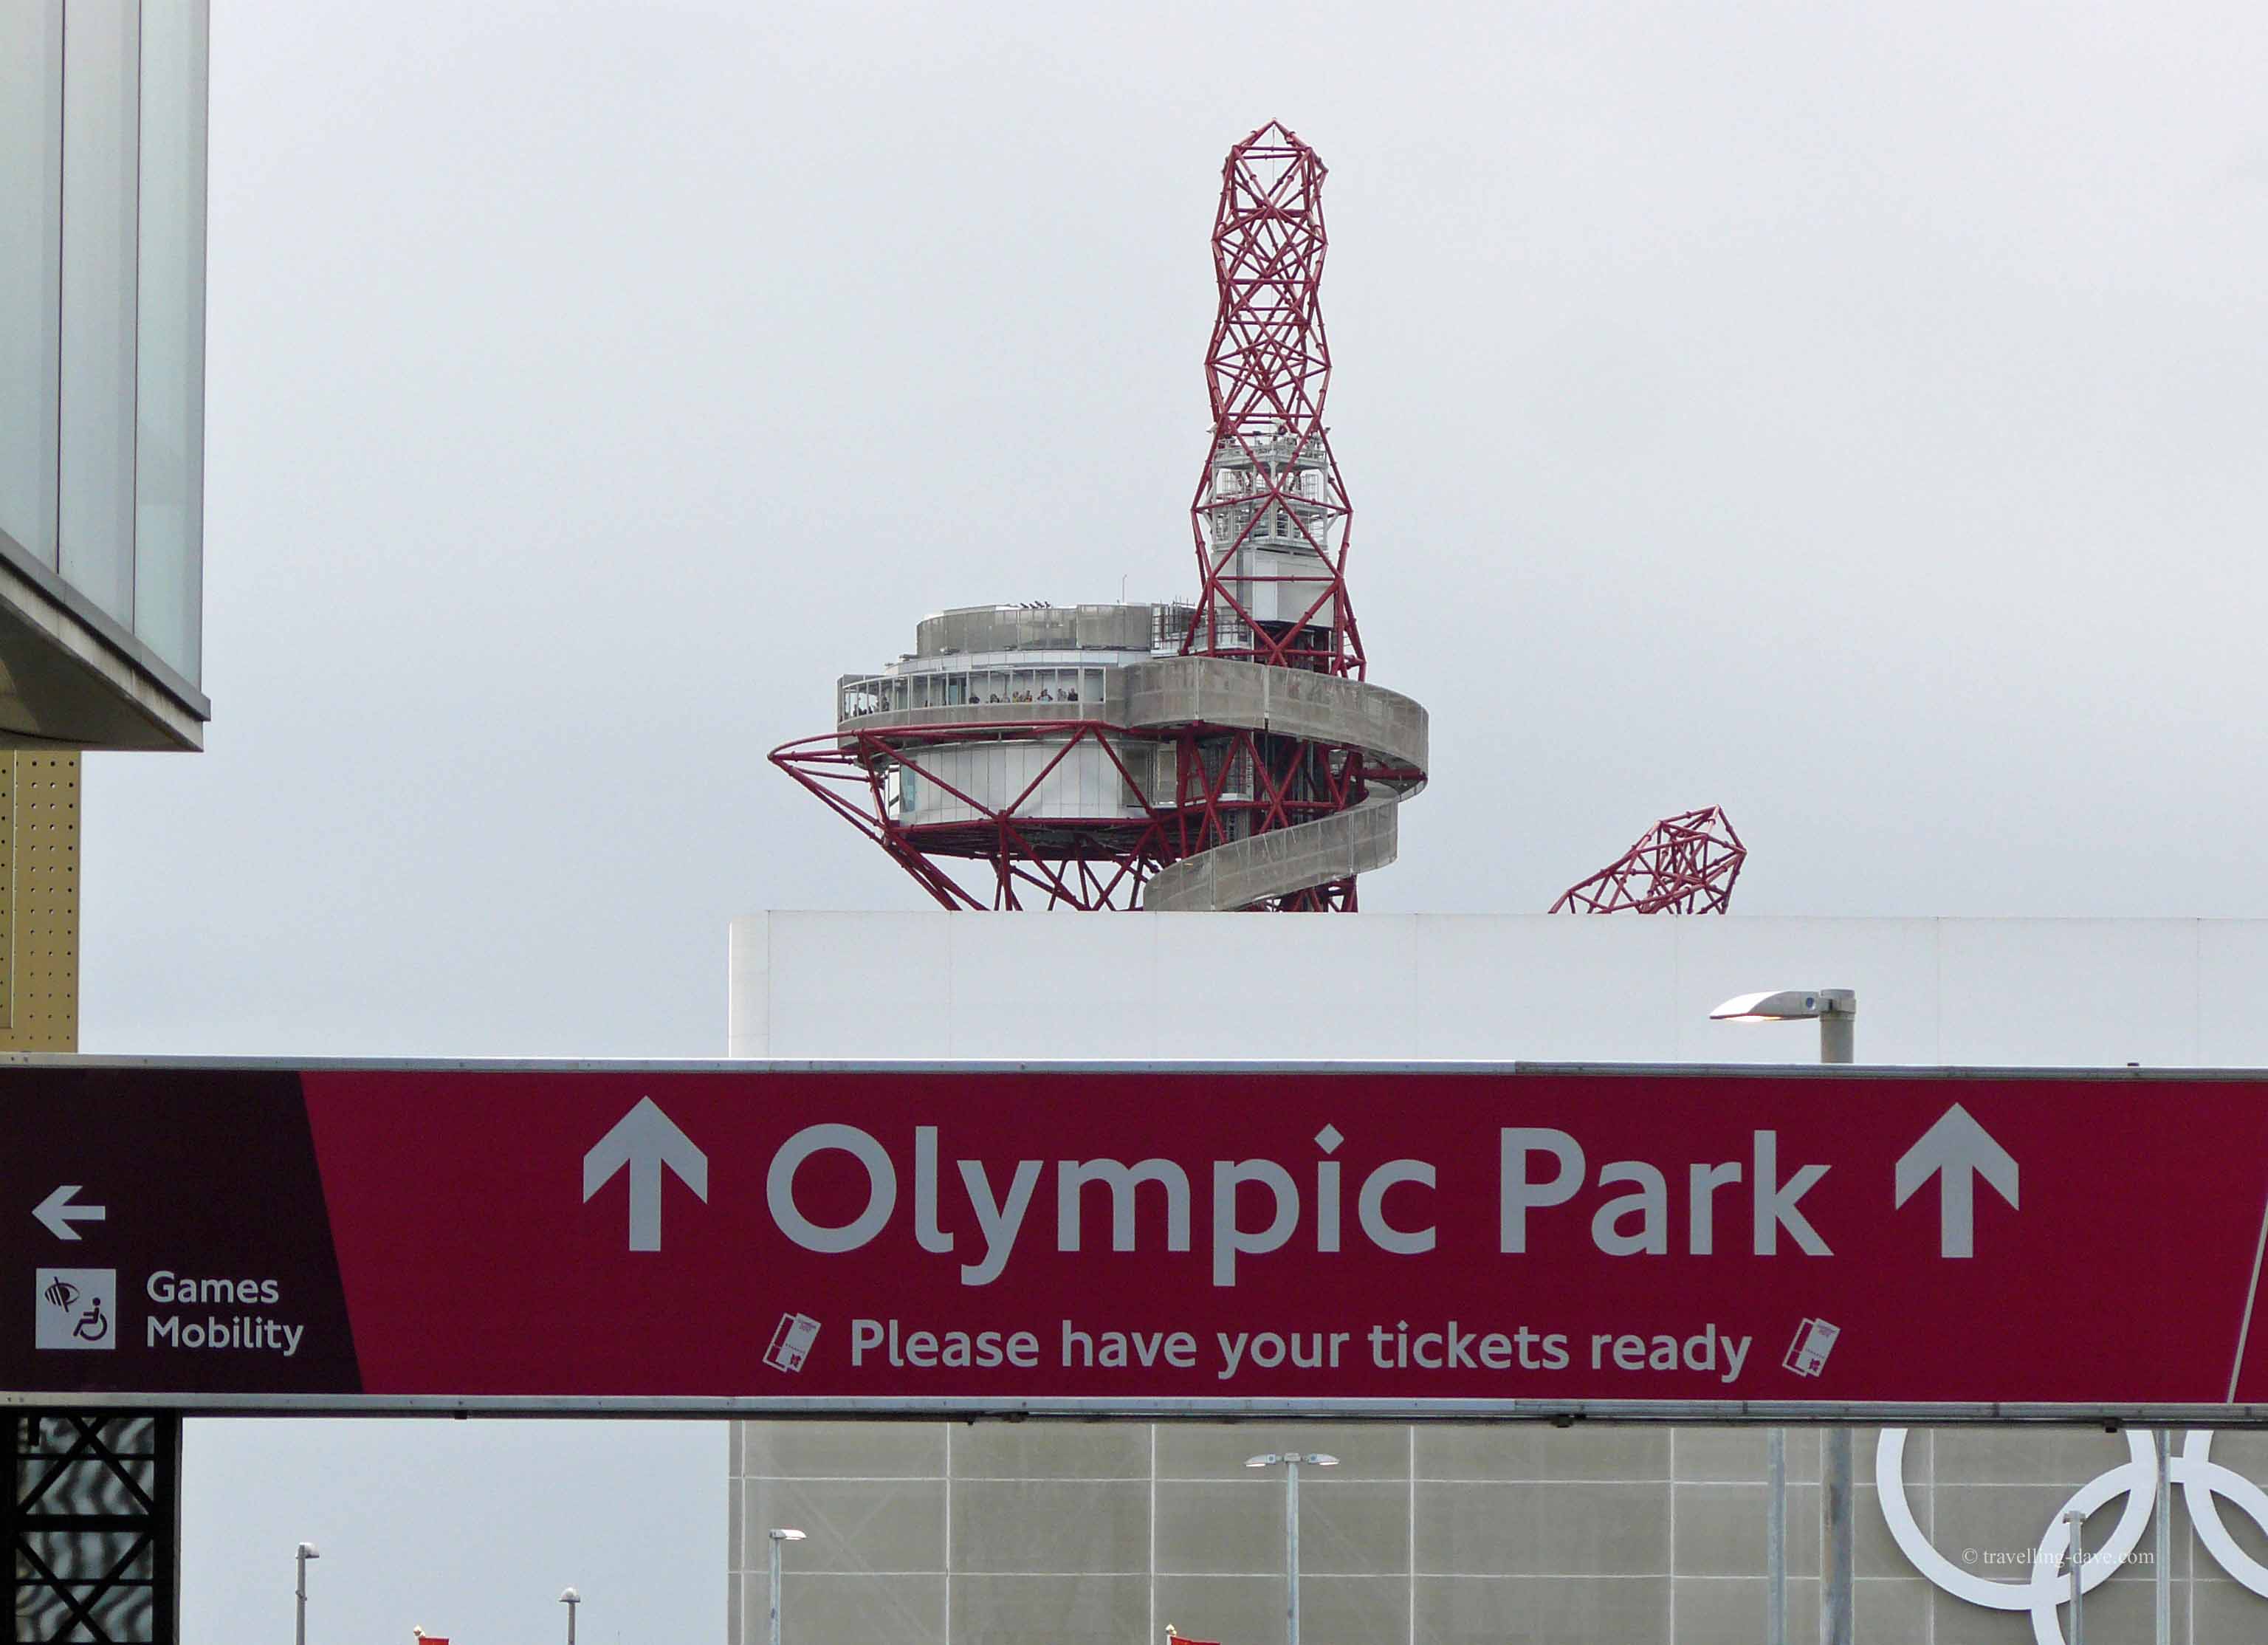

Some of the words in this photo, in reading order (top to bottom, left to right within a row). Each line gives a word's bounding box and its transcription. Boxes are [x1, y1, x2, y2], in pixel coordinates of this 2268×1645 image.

[766, 1122, 1437, 1287] Olympic
[1499, 1127, 1835, 1257] Park
[147, 1271, 279, 1303] Games
[147, 1316, 304, 1356] Mobility
[852, 1319, 1040, 1367] Please
[1062, 1319, 1197, 1367] have
[1217, 1332, 1350, 1380] your
[1367, 1320, 1570, 1370] tickets
[1592, 1323, 1752, 1383] ready
